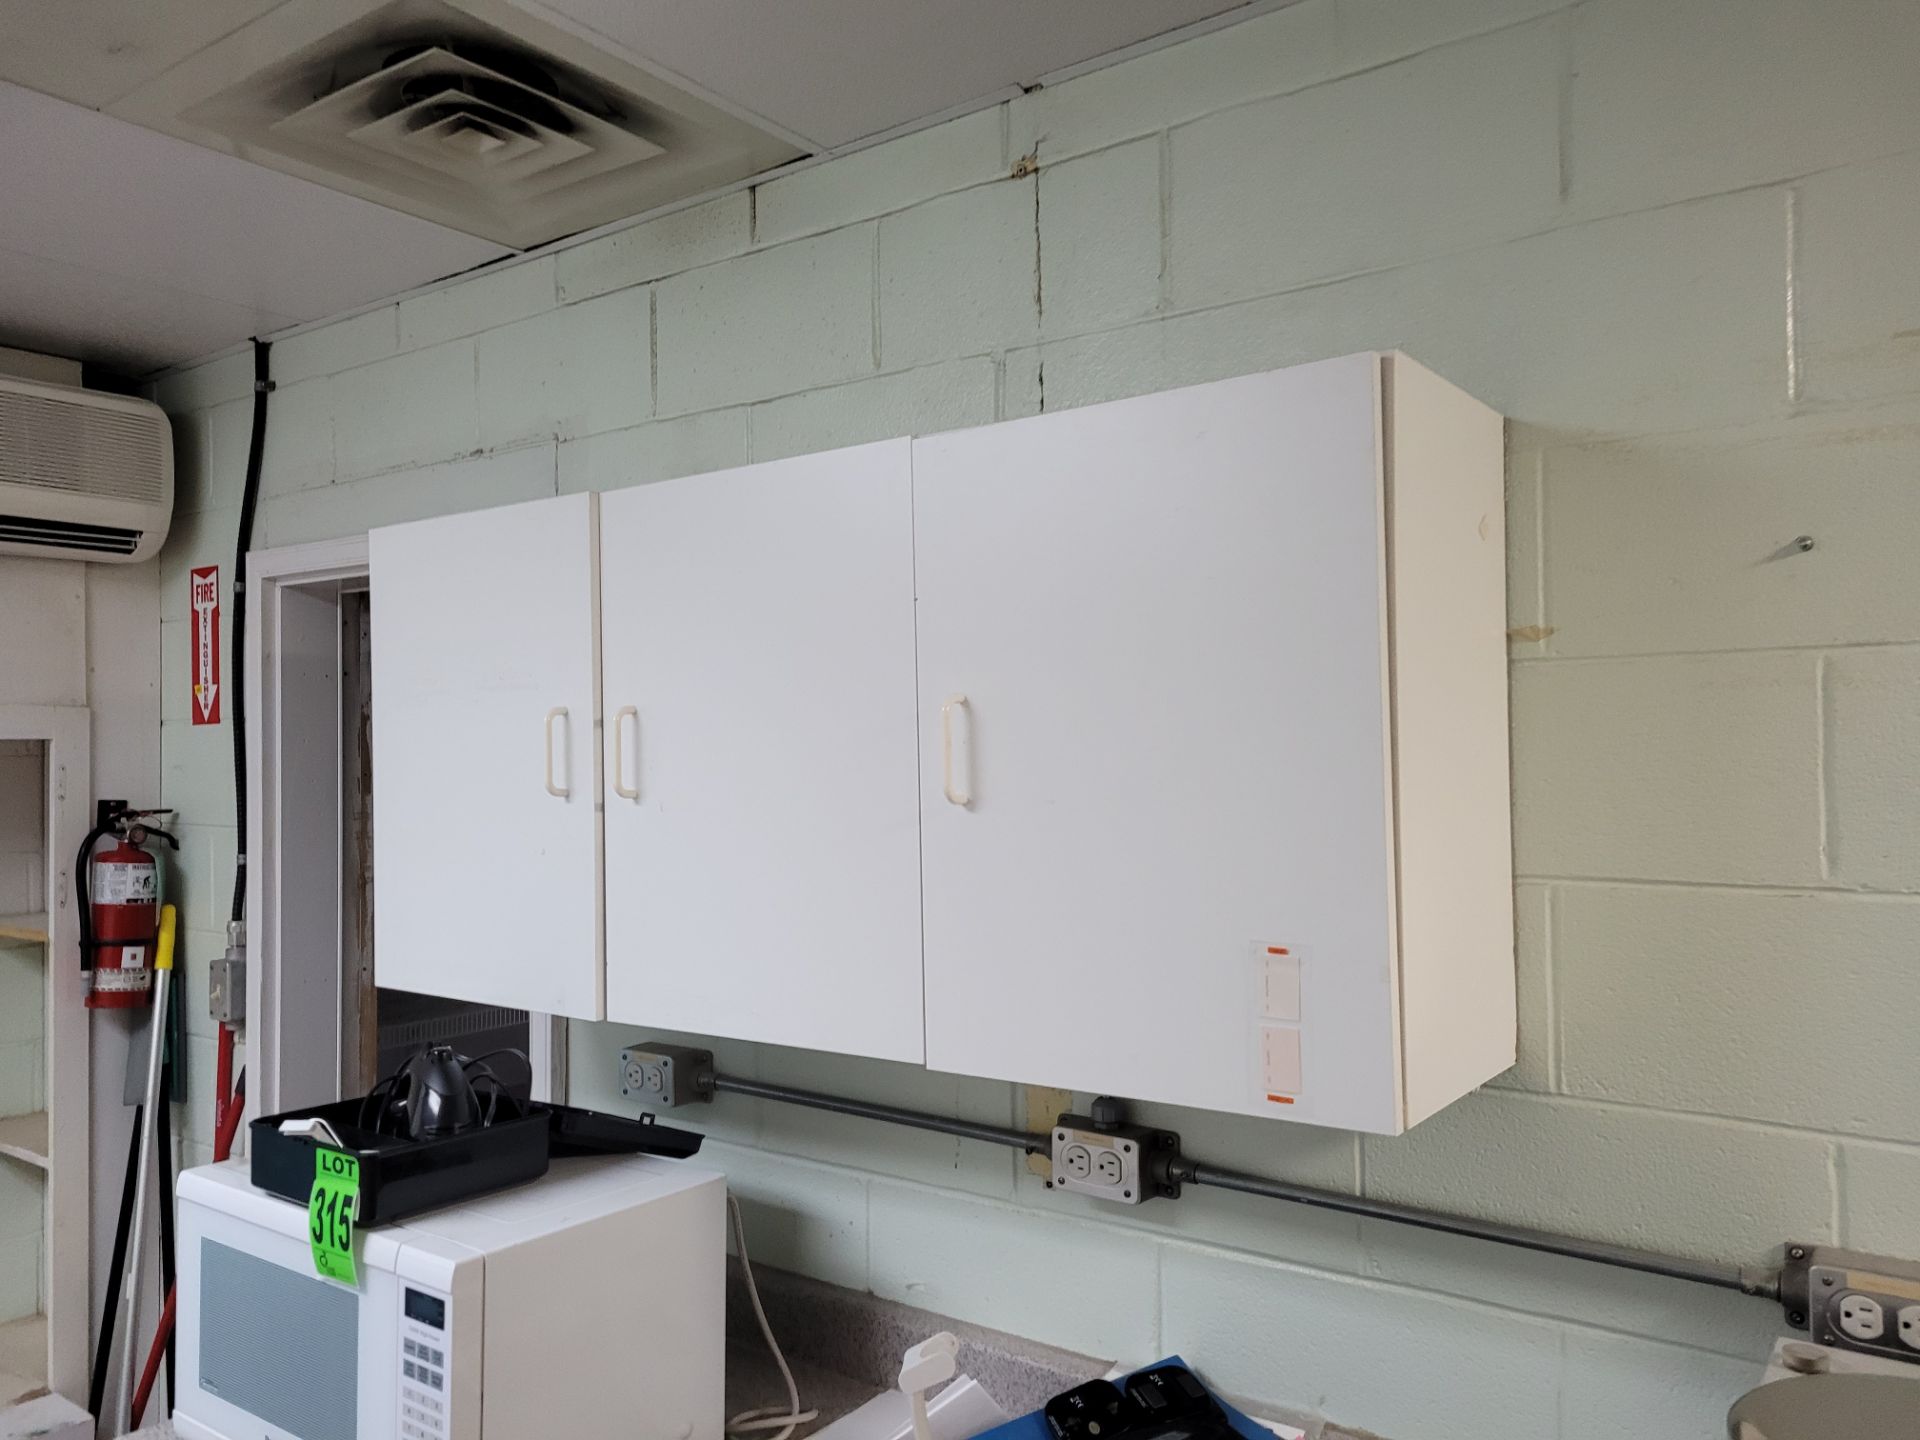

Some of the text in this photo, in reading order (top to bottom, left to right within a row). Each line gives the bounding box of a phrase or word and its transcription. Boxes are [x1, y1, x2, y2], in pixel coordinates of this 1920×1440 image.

[195, 582, 214, 604] FIRE
[322, 1153, 356, 1177] LOT
[311, 1187, 354, 1252] 315
